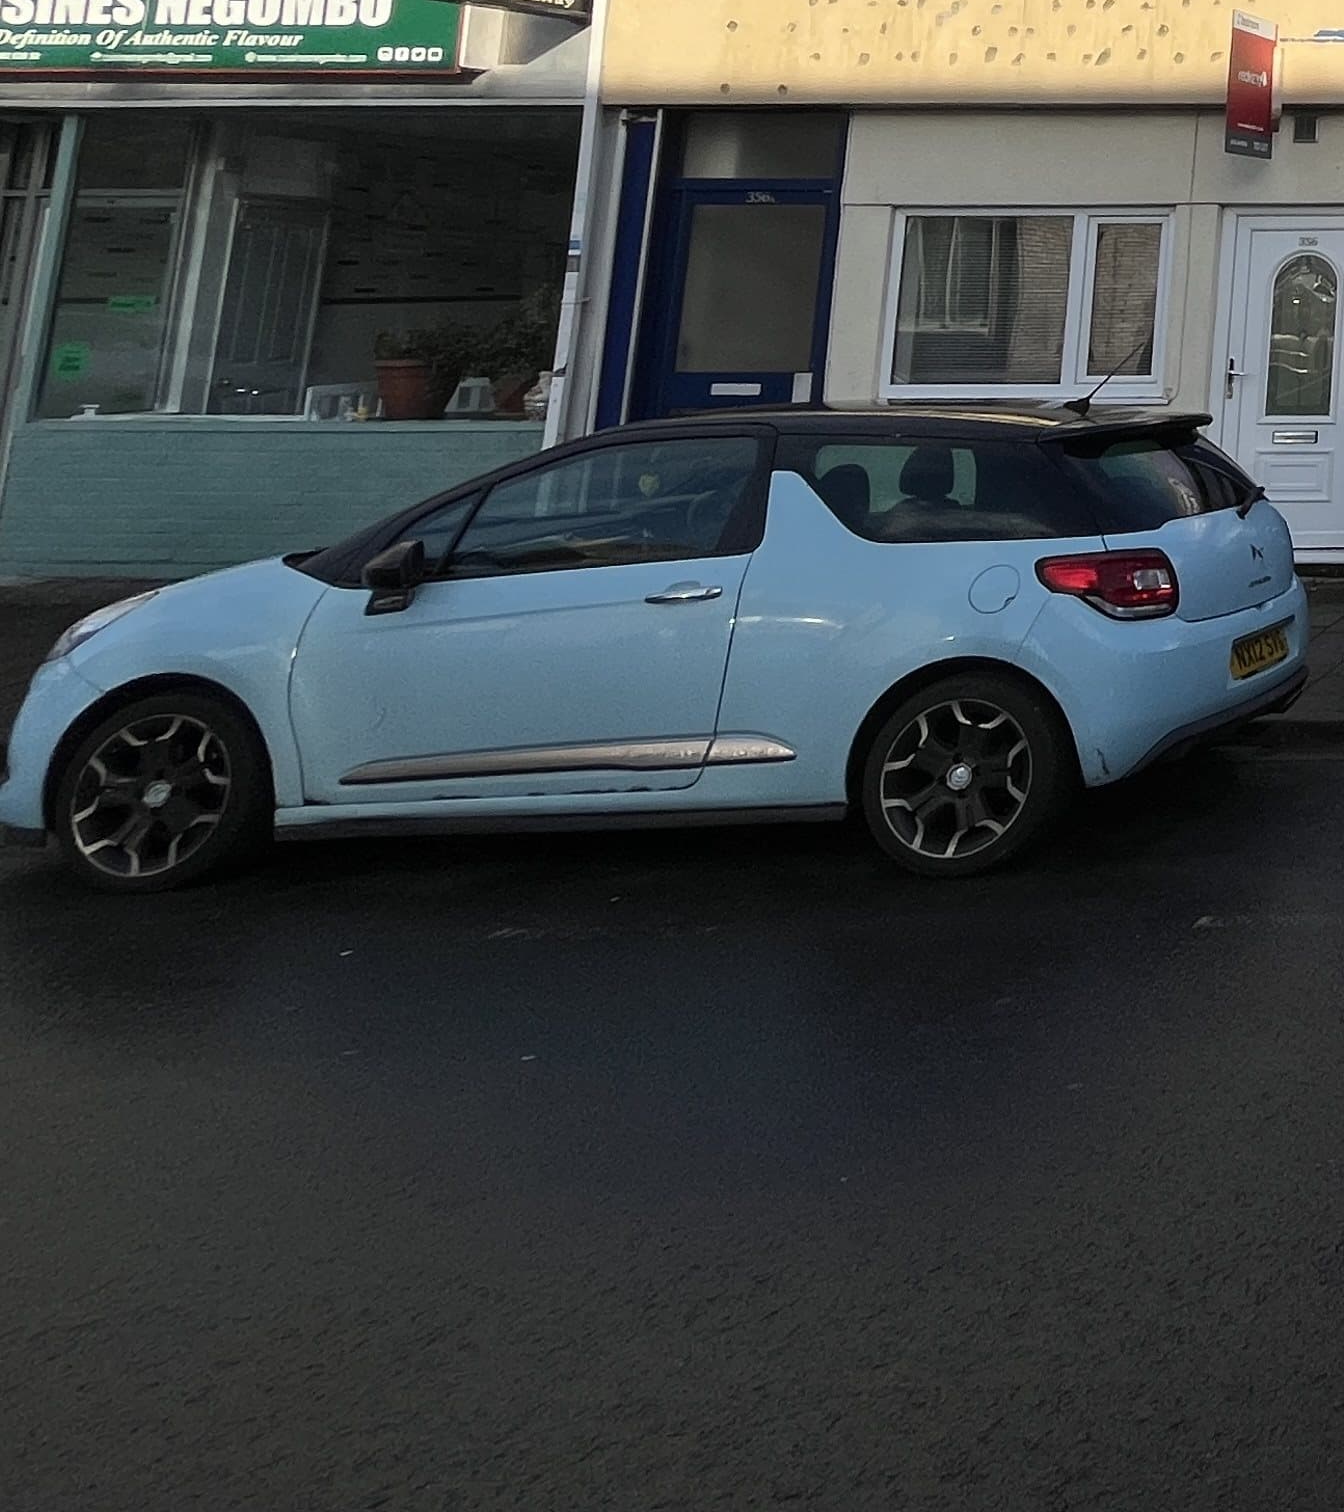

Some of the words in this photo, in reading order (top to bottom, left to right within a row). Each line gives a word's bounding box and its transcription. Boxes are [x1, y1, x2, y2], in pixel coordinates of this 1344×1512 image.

[96, 29, 128, 50] Of
[124, 29, 220, 46] Authentic
[222, 29, 304, 47] Flavour
